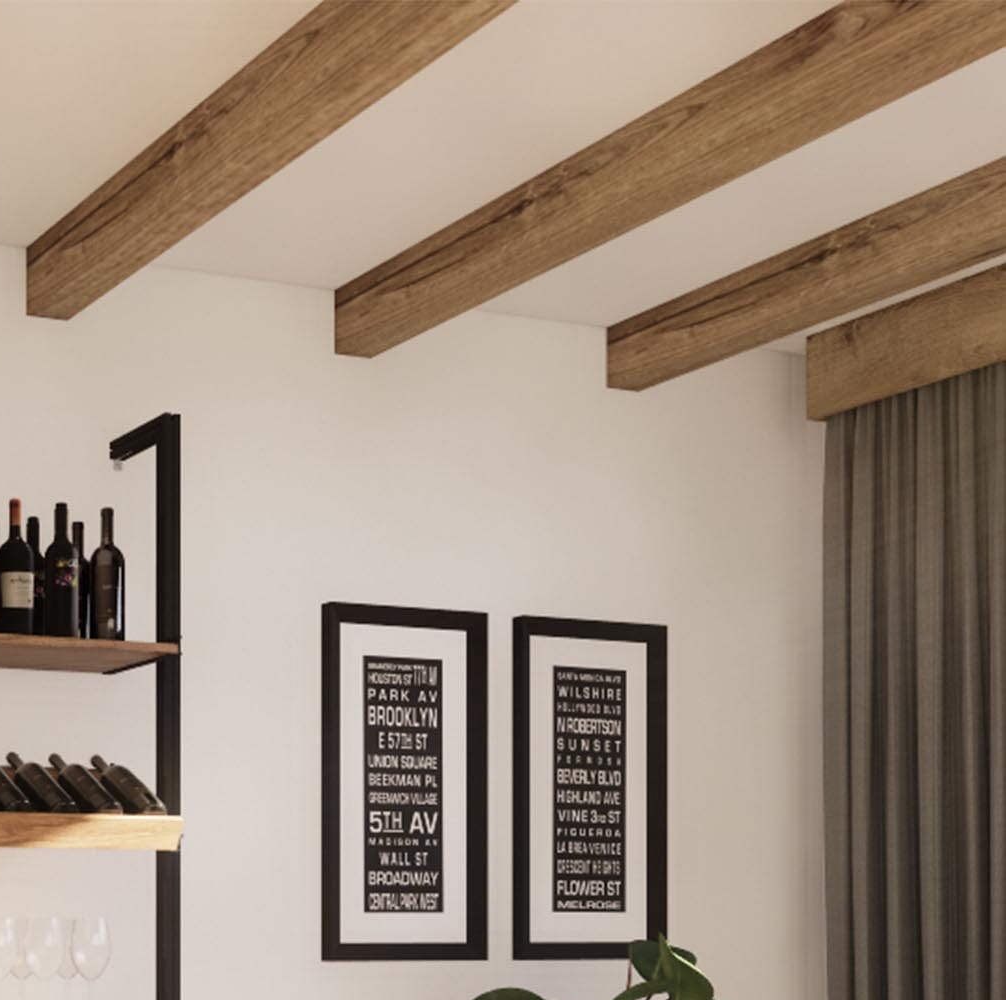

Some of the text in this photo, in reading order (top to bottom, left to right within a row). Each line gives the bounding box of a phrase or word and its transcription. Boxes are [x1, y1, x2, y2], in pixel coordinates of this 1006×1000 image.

[367, 688, 438, 703] PARK AV
[557, 685, 622, 701] WILSHIRE
[368, 705, 438, 728] BROOKLYN
[557, 717, 622, 736] N ROBERTSON
[379, 731, 385, 749] E
[415, 733, 428, 750] ST
[557, 738, 622, 753] SUNSET
[368, 753, 438, 770] UNION SQUARE
[368, 773, 438, 788] BEEKMAN PL
[557, 768, 622, 786] BEVERLY BLVD
[557, 789, 602, 805] HIGHLAND
[369, 811, 438, 835] 5TH AV
[557, 809, 588, 823] VINE
[607, 810, 622, 824] ST
[557, 827, 622, 838] FIGUEROA
[369, 837, 438, 847] MADISON AV
[589, 842, 621, 856] VENICE
[379, 851, 429, 867] WALL ST
[368, 870, 439, 887] BROADWAY
[557, 879, 621, 897] FLOWER ST
[557, 900, 621, 909] MELROSE
